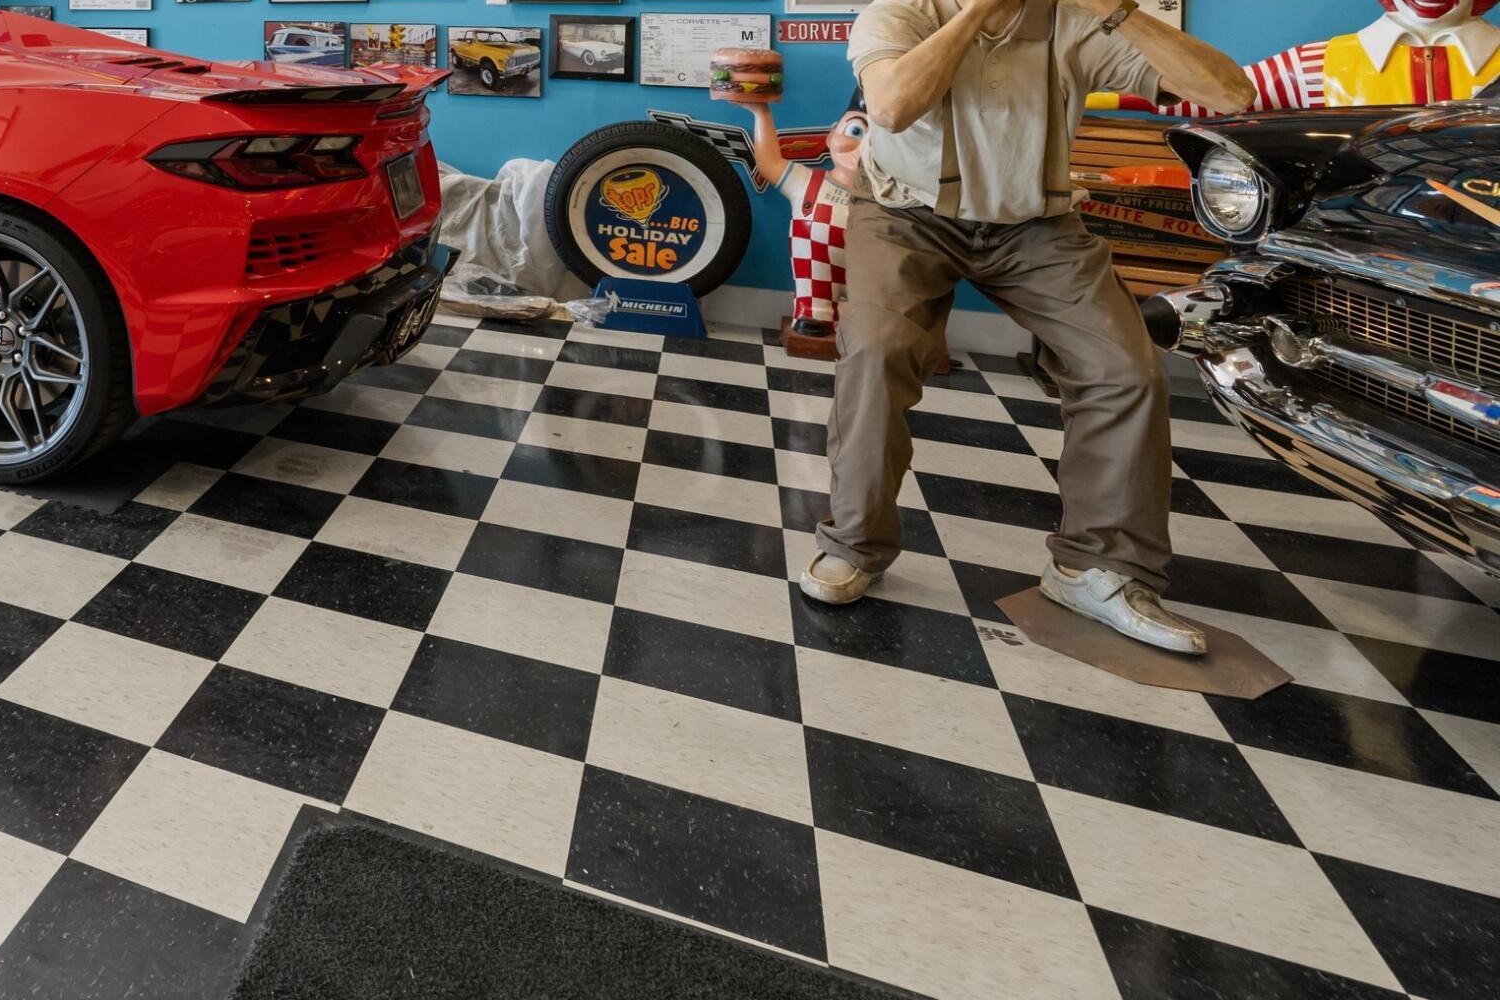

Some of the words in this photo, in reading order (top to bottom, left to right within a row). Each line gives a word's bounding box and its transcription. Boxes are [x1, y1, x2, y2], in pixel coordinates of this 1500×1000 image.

[741, 30, 754, 41] M
[787, 21, 851, 41] CORVET
[677, 72, 686, 81] C
[606, 182, 656, 214] tops
[1080, 200, 1144, 224] WHITE
[598, 223, 693, 246] HOLIDAY
[1162, 217, 1221, 241] ROC
[608, 237, 677, 271] Sale
[621, 300, 684, 313] MICHELIN
